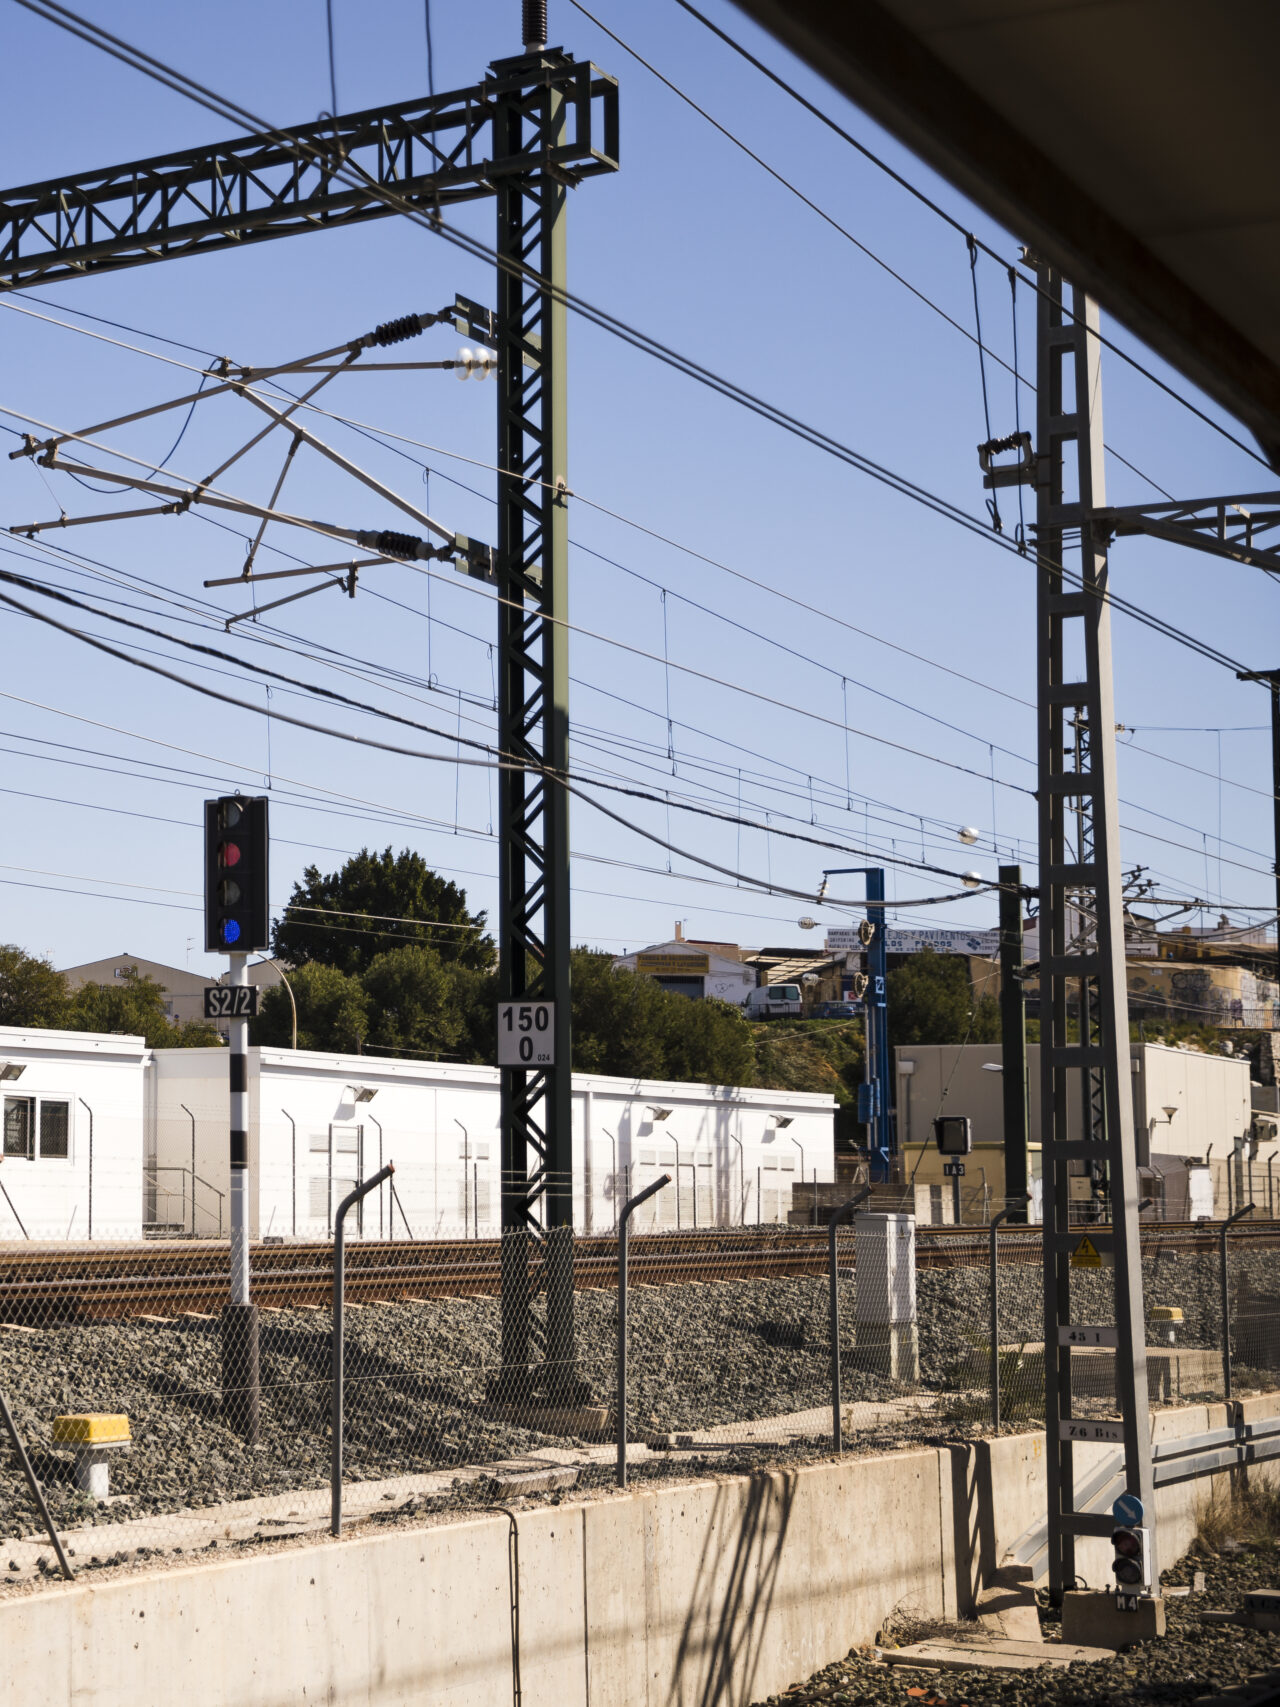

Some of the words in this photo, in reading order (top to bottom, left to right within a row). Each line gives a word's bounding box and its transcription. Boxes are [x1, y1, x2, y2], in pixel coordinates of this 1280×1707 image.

[209, 987, 251, 1016] S2/2
[502, 1006, 549, 1032] 150
[519, 1035, 534, 1062] 0
[537, 1054, 550, 1062] 024
